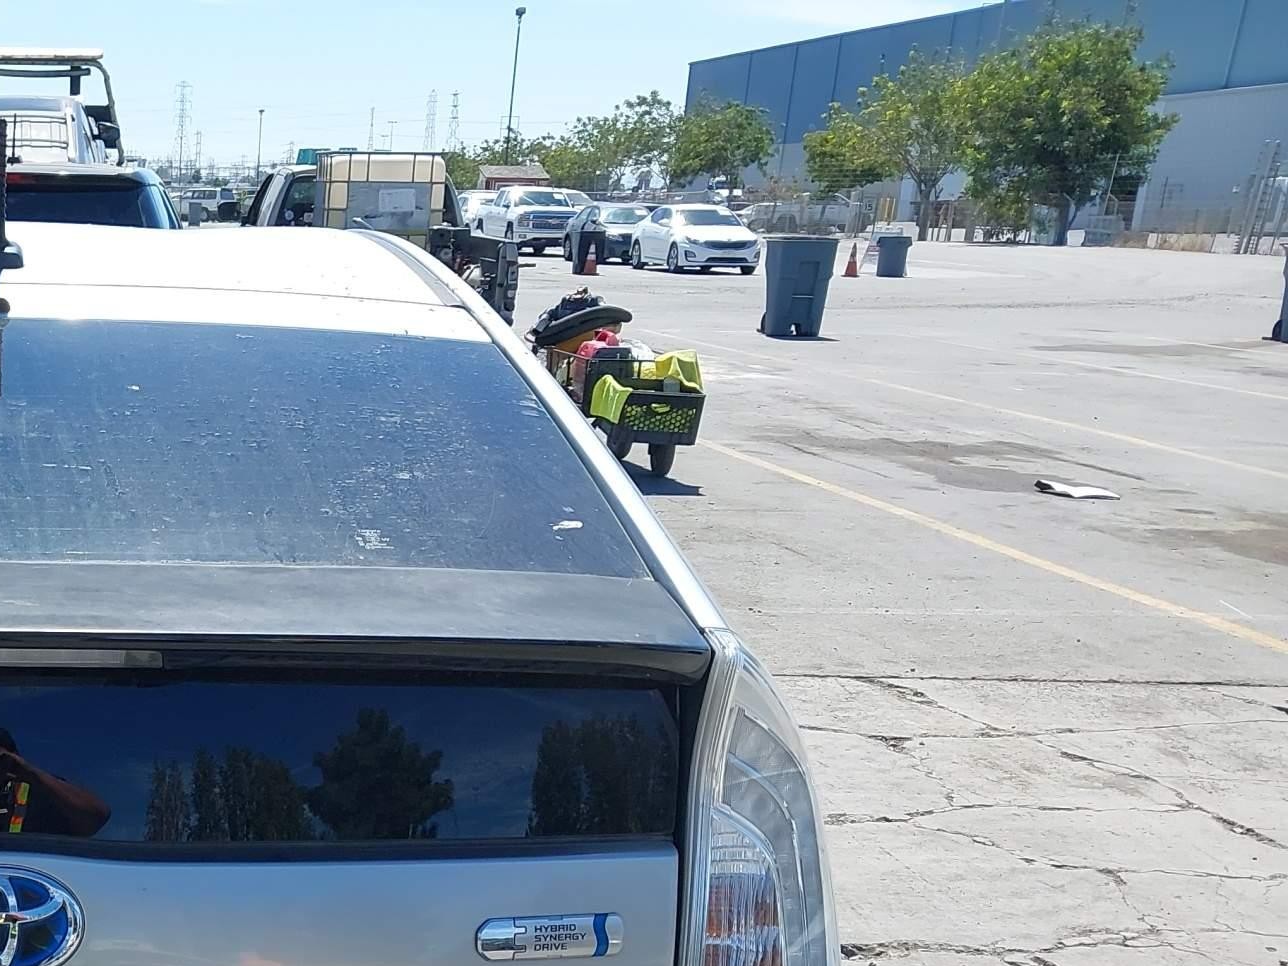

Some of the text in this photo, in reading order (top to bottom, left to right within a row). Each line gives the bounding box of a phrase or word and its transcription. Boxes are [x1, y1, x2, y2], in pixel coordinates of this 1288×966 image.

[534, 923, 577, 933] HYBRID
[534, 932, 587, 942] SYNERGY
[534, 942, 568, 951] DRIVE
